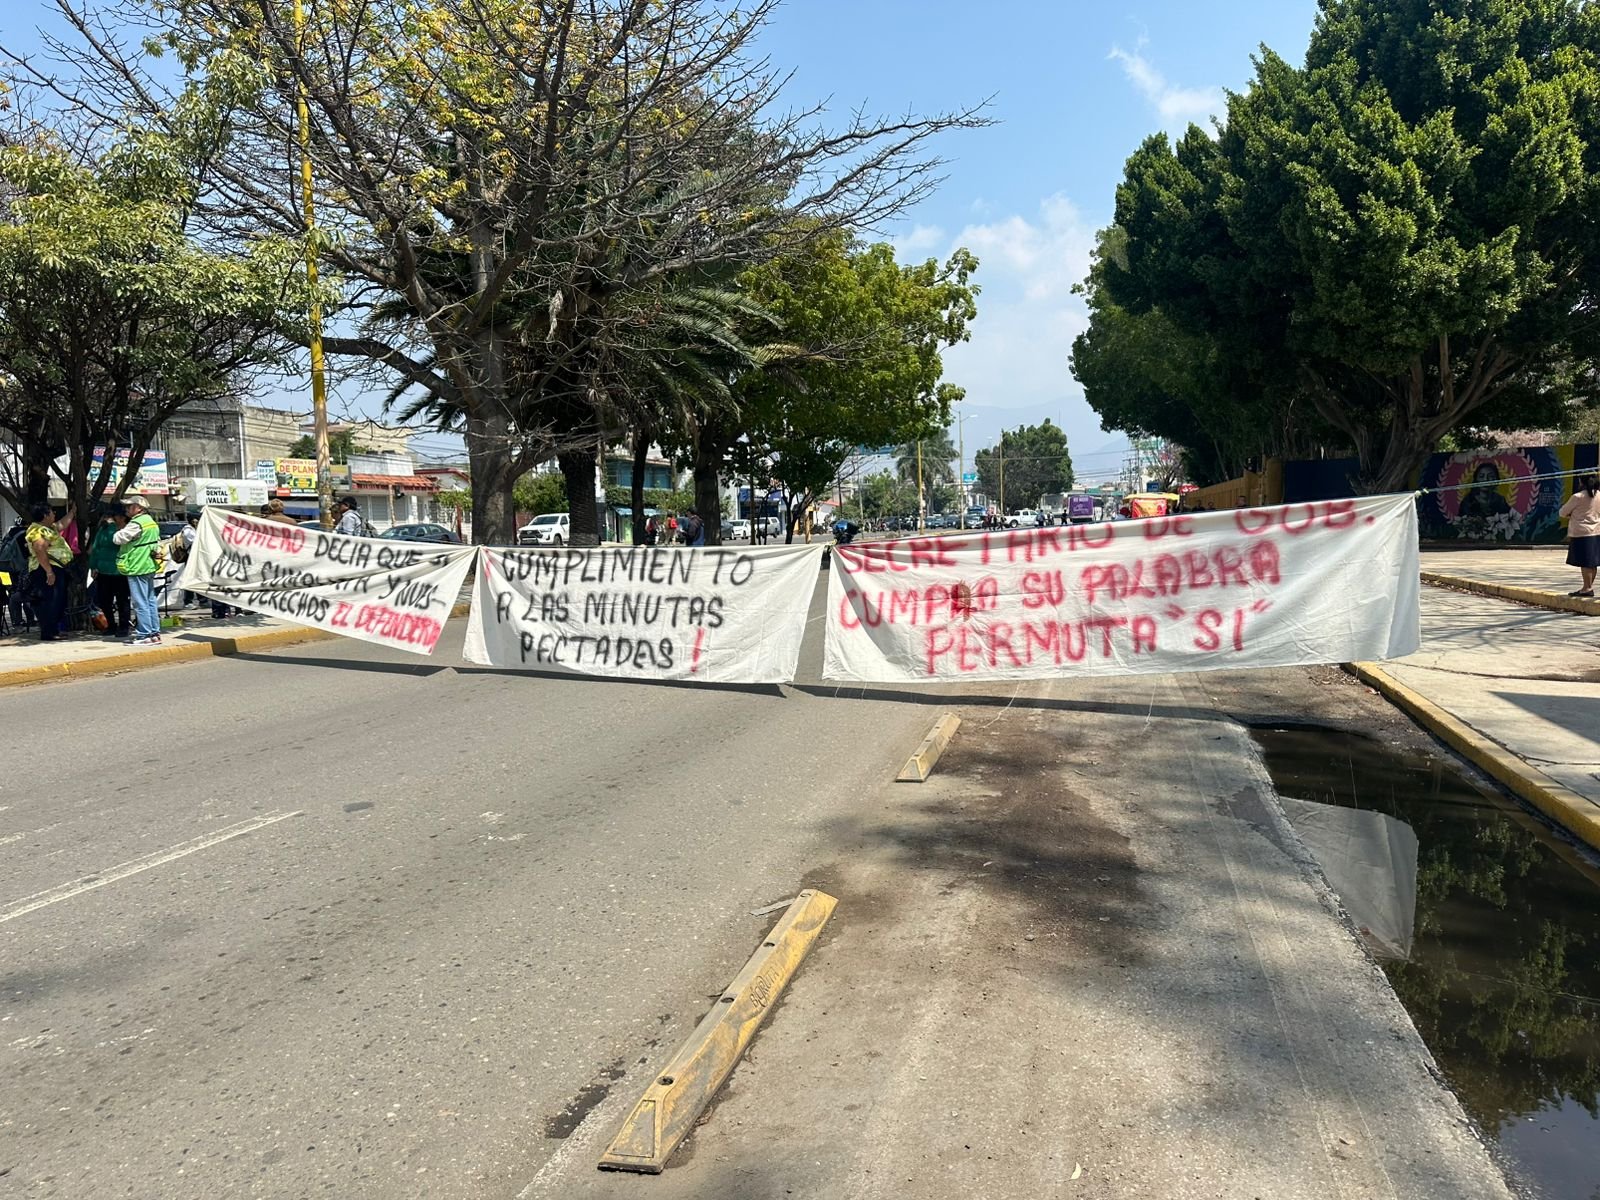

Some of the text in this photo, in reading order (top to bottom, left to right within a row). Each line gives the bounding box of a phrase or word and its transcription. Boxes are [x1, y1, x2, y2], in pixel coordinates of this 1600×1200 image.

[221, 515, 305, 554] ROMERO
[314, 534, 372, 569] DECIA
[377, 546, 423, 570] QUE
[1144, 515, 1193, 541] DE
[211, 549, 252, 582] NOS
[378, 574, 401, 600] Y
[1022, 570, 1064, 609] SU
[1081, 539, 1281, 602] PALABRA
[247, 590, 330, 622] DERECHOS
[331, 601, 353, 628] EL
[496, 591, 724, 628] A LAS MINUTAS
[926, 613, 1157, 676] PERMUTA
